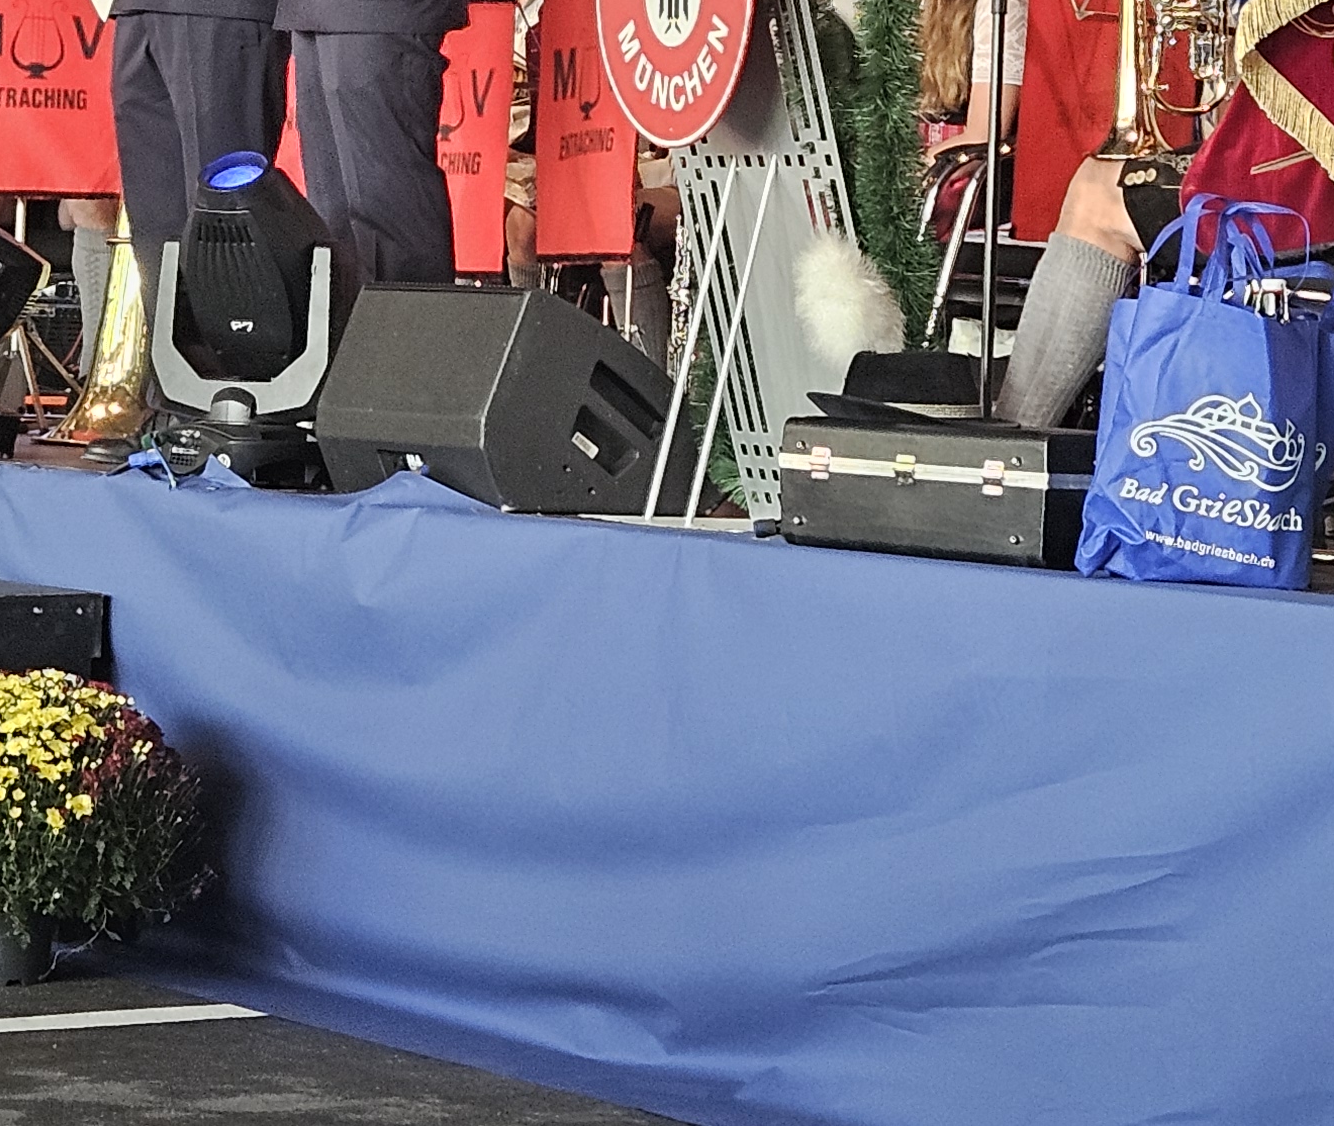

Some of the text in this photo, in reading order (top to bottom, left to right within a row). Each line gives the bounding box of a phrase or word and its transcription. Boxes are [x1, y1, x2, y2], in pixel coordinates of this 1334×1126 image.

[72, 15, 106, 59] V
[618, 14, 730, 112] MÜNCHEN
[1119, 477, 1169, 505] Bad
[1145, 530, 1276, 569] www.badgriesbach.de
